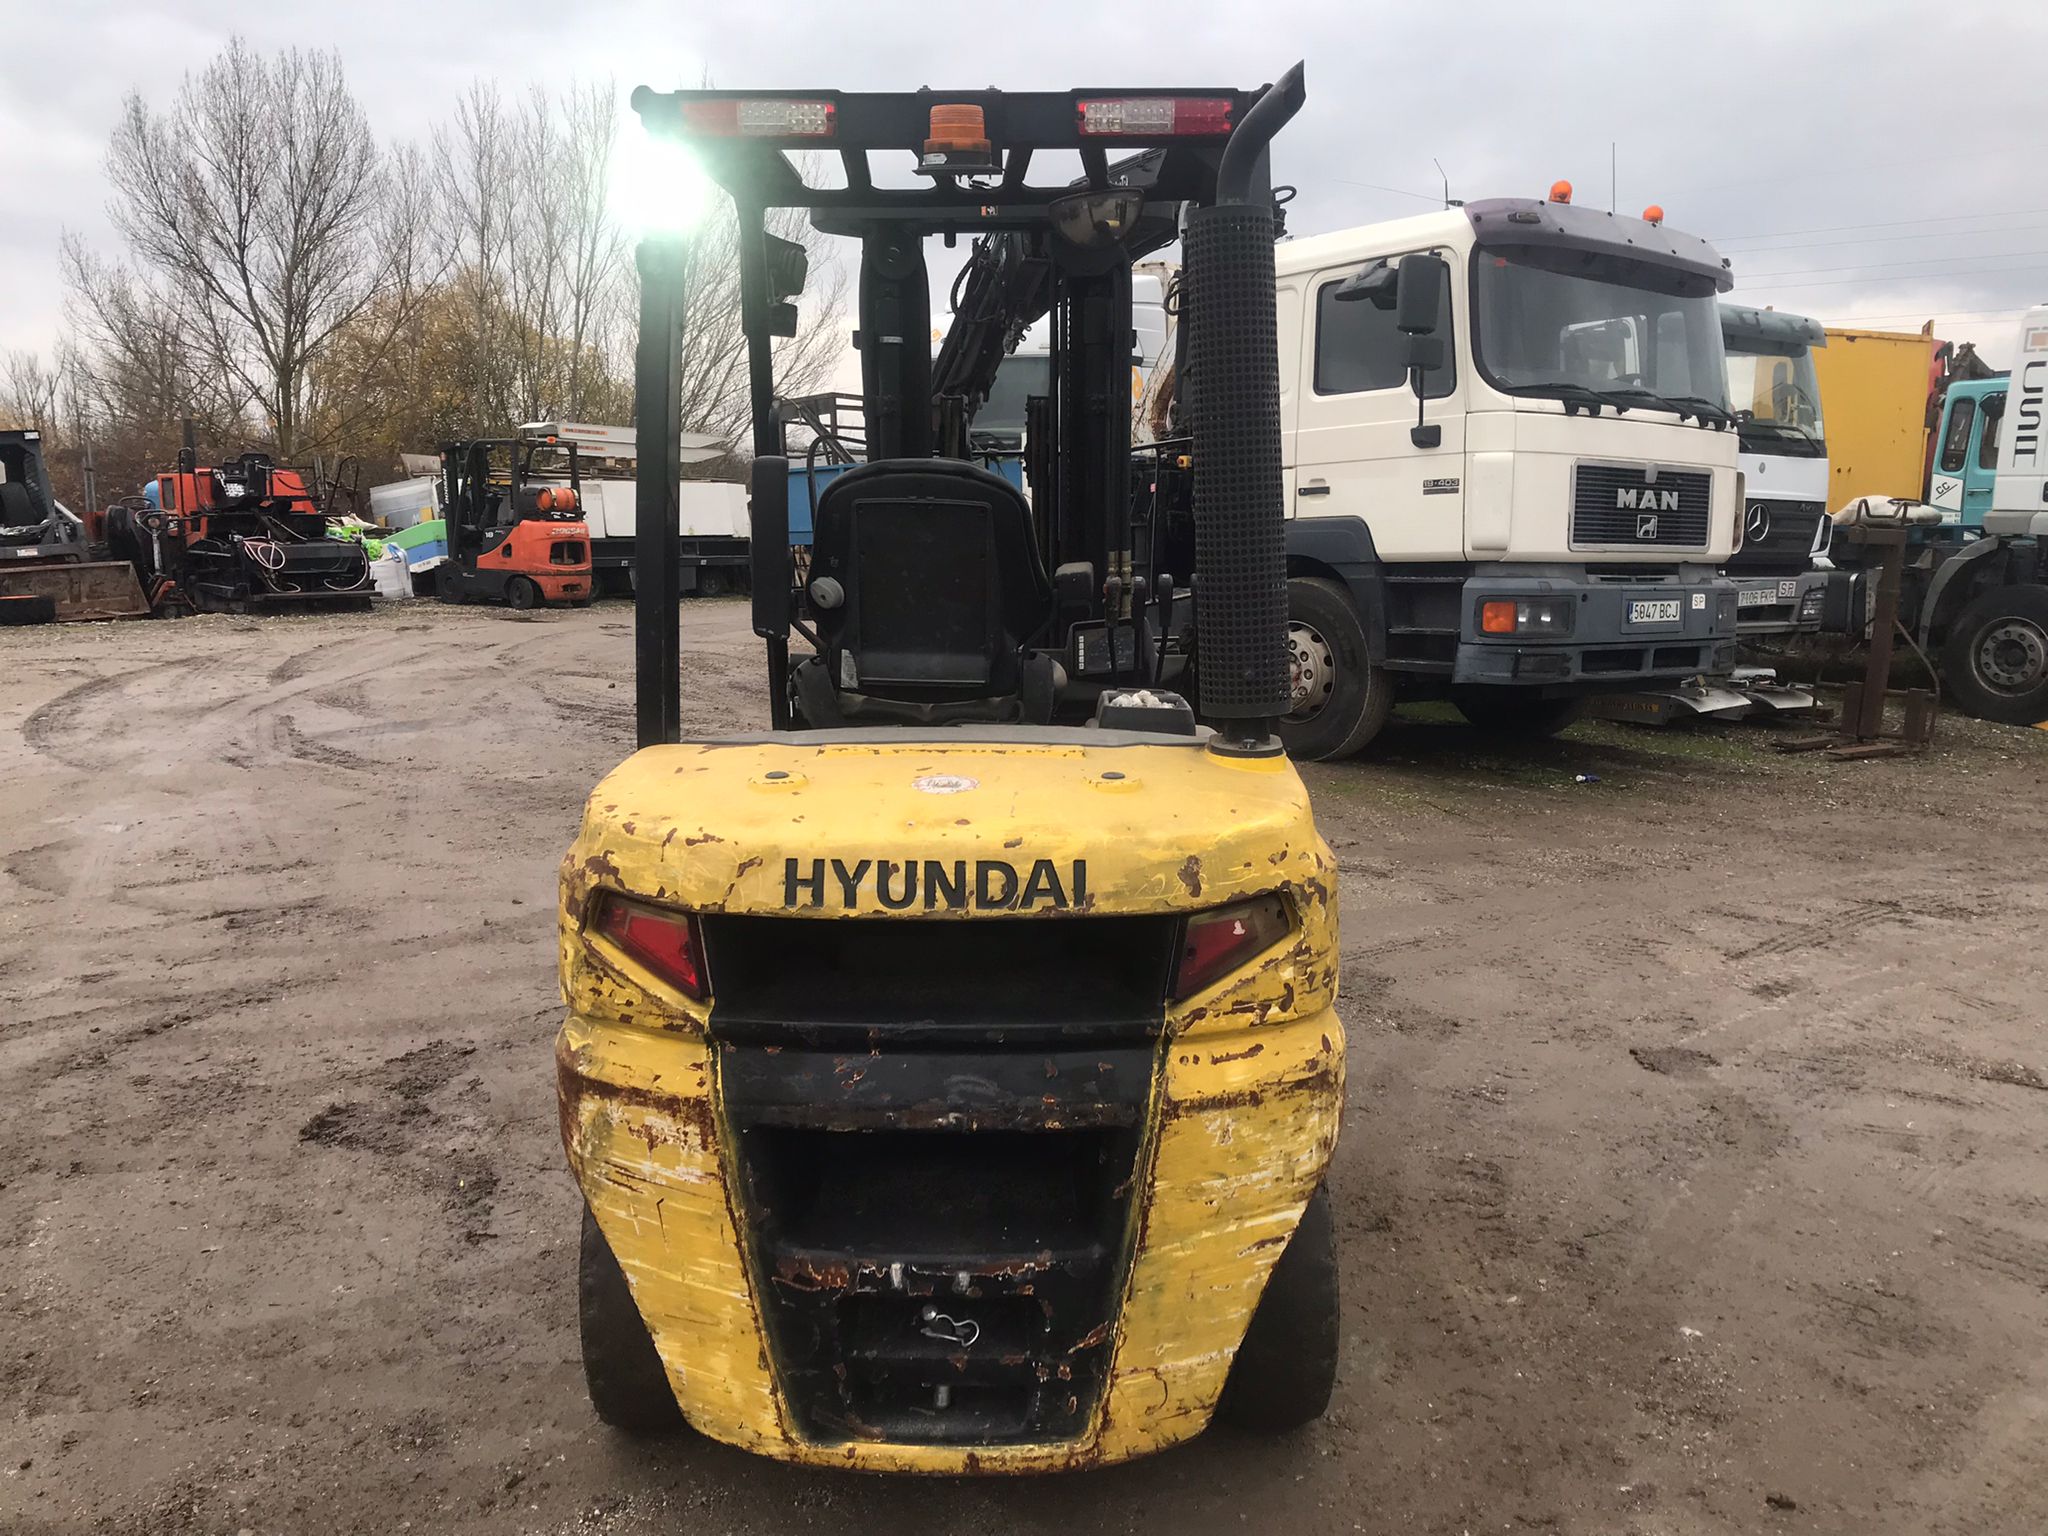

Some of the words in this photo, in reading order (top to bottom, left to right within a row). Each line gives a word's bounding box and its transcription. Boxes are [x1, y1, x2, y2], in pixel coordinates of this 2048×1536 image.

[1616, 488, 1679, 511] MAN
[1659, 602, 1679, 619] BCJ
[1693, 596, 1705, 607] SP
[784, 858, 1087, 910] HYUNDAI
